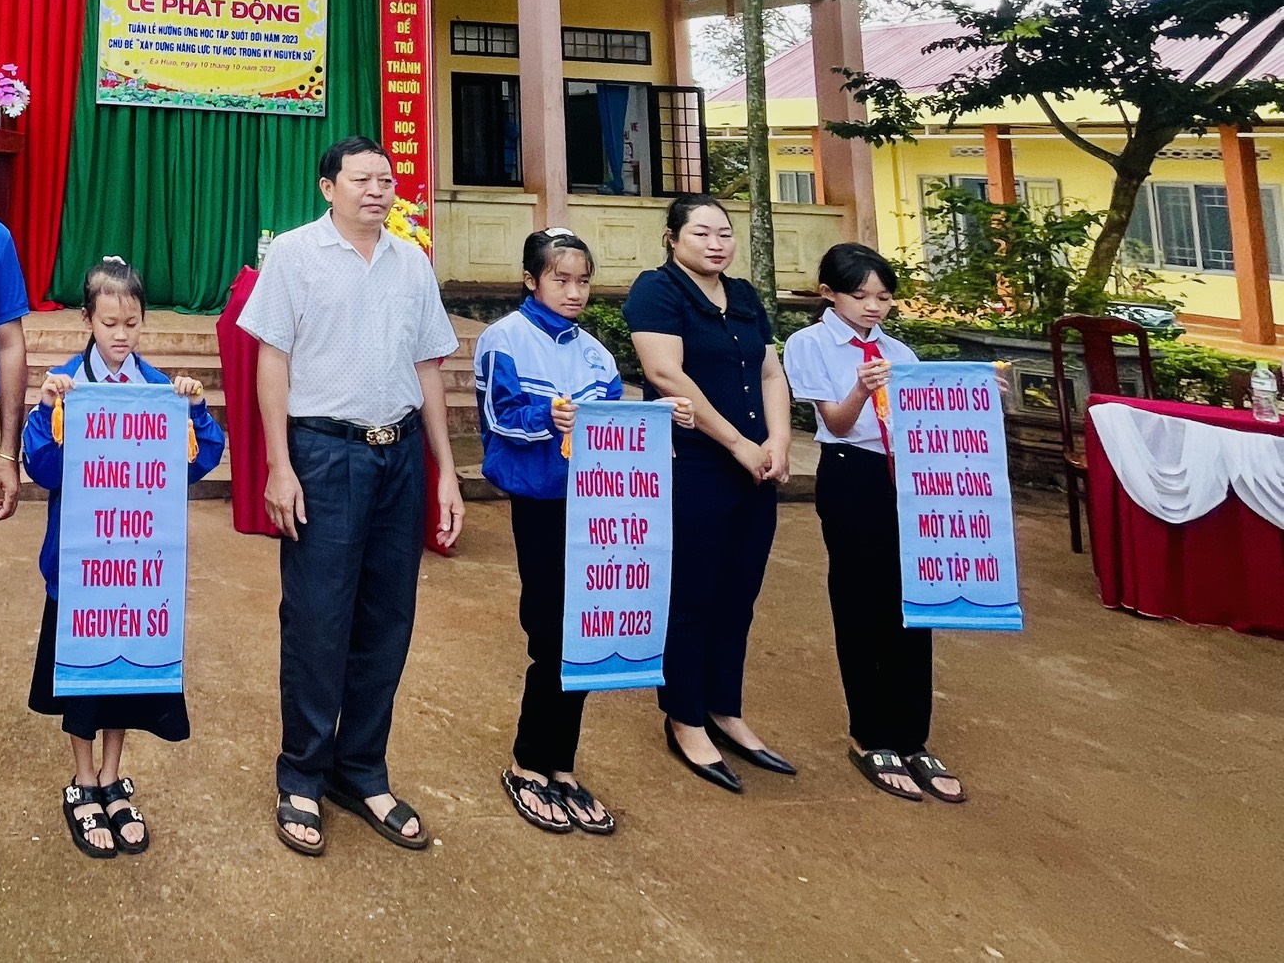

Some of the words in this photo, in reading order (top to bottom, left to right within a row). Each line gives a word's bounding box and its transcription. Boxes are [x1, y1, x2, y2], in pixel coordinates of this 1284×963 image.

[390, 0, 417, 15] SÁCH
[282, 35, 298, 44] 2023
[397, 18, 410, 34] ĐỂ
[239, 48, 261, 57] TRONG
[394, 39, 414, 55] TRỞ
[387, 58, 421, 74] THÀNH
[388, 79, 420, 94] NGƯỜI
[398, 100, 412, 116] TỰ
[394, 120, 415, 136] HỌC
[392, 139, 418, 155] SUỐT
[397, 159, 414, 175] ĐỜI
[899, 378, 944, 411] CHUYỂN
[948, 378, 968, 411] ĐỔI
[974, 379, 990, 411] SỐ
[85, 407, 117, 439] XÂY
[123, 411, 167, 446] DỰNG
[586, 418, 624, 451] TUẦN
[629, 418, 646, 451] LỄ
[908, 419, 924, 453] ĐỂ
[928, 425, 948, 453] XÂY
[952, 427, 988, 458] DỰNG
[83, 455, 129, 488] NĂNG
[136, 459, 166, 494] LỰC
[576, 462, 624, 497] HƯỞNG
[629, 467, 659, 497] ỨNG
[912, 467, 954, 496] THÀNH
[956, 467, 992, 496] CÔNG
[95, 507, 117, 544] TỰ
[120, 510, 153, 544] HỌC
[589, 518, 617, 550] HỌC
[622, 513, 648, 550] TẬP
[918, 509, 945, 543] MỘT
[949, 510, 966, 538] XÃ
[970, 509, 991, 544] HỘI
[81, 559, 136, 586] TRONG
[142, 550, 163, 586] KỶ
[586, 555, 622, 590] SUỐT
[626, 557, 650, 589] ĐỜI
[918, 557, 943, 587] HỌC
[946, 553, 970, 587] TẬP
[975, 556, 999, 582] MỚI
[72, 604, 140, 637] NGUYÊN
[147, 598, 169, 637] SỐ
[581, 606, 614, 637] NĂM
[619, 610, 651, 636] 2023
